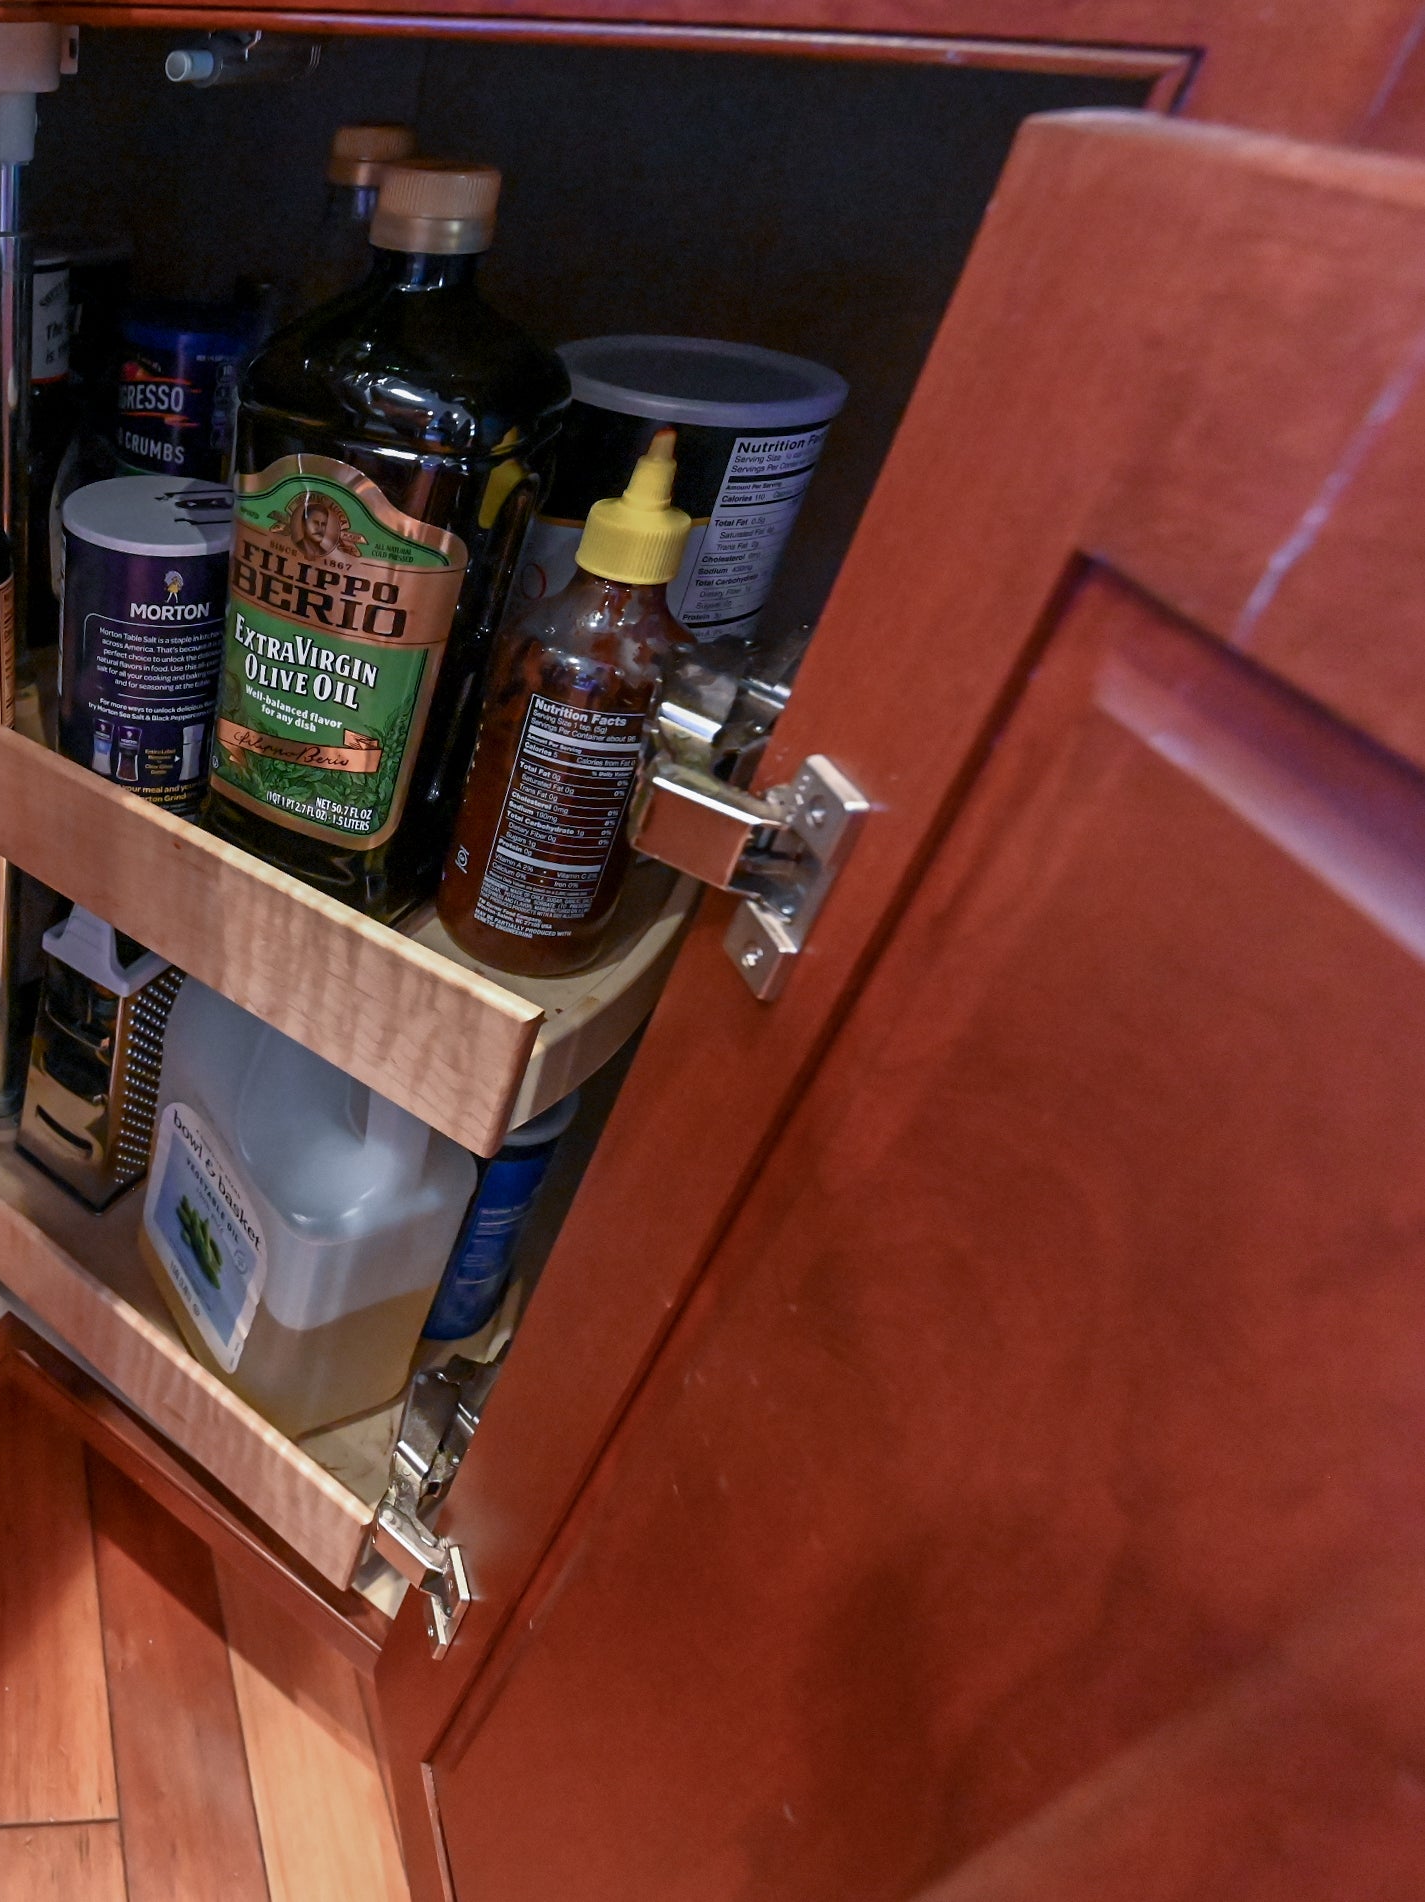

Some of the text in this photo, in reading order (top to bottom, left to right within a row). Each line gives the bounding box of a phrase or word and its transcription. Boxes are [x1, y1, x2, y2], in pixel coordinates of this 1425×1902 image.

[125, 431, 185, 464] CRUMBS
[737, 439, 805, 453] Nutrition
[734, 454, 781, 464] Serving Size
[731, 464, 765, 473] Servings
[721, 494, 753, 503] Calories
[714, 518, 748, 527] Total Fat
[270, 540, 297, 557] SINCE
[702, 554, 746, 563] Cholesterol
[241, 540, 399, 605] FILIPPO
[696, 579, 714, 587] Total
[232, 560, 408, 639] BERIO
[130, 602, 210, 622] MORTON
[99, 627, 192, 645] Morton Table Salt staple
[102, 639, 179, 654] across America. That's
[96, 655, 142, 671] natural flavors
[103, 648, 127, 659] perfect
[128, 654, 152, 662] choice
[115, 679, 174, 692] and seasoning
[127, 672, 172, 683] your cooking
[245, 653, 359, 710] OLIVE OIL
[97, 705, 119, 716] Morton
[110, 701, 127, 710] more
[245, 683, 343, 729] Well-balanced flavor
[535, 698, 627, 727] Nutrition Facts
[261, 704, 317, 733] for any dish
[533, 709, 608, 735] Serving Size (5g)
[531, 717, 557, 733] Servings
[558, 727, 571, 735] Per
[571, 730, 605, 741] Container
[524, 741, 552, 756] Calories
[527, 733, 582, 754] Amount Serving
[519, 761, 551, 778] Total Fat
[577, 757, 603, 766] Calories
[164, 785, 180, 793] and
[519, 783, 548, 799] Trans Fat
[521, 773, 564, 793] Saturated Fat
[164, 793, 187, 802] Grind
[511, 791, 552, 811] Cholesterol
[286, 798, 370, 831] PT 2.7 FL OZ) 1.5 LITERS
[316, 797, 373, 820] NET 50.7 FL OZ
[508, 800, 534, 815] Sodium
[506, 810, 575, 835] Total Carbohydrate
[508, 821, 547, 840] Dietary Fiber
[498, 838, 523, 852] Protein
[505, 831, 527, 845] Sugars
[495, 853, 516, 866] Vitamin
[491, 861, 516, 878] Calcium
[556, 871, 580, 879] Vitamin
[494, 917, 524, 932] PARTIALLY
[173, 1108, 203, 1159] bowl
[218, 1174, 262, 1252] basket
[186, 1156, 226, 1220] VEGETABLE
[226, 1222, 240, 1244] OIL
